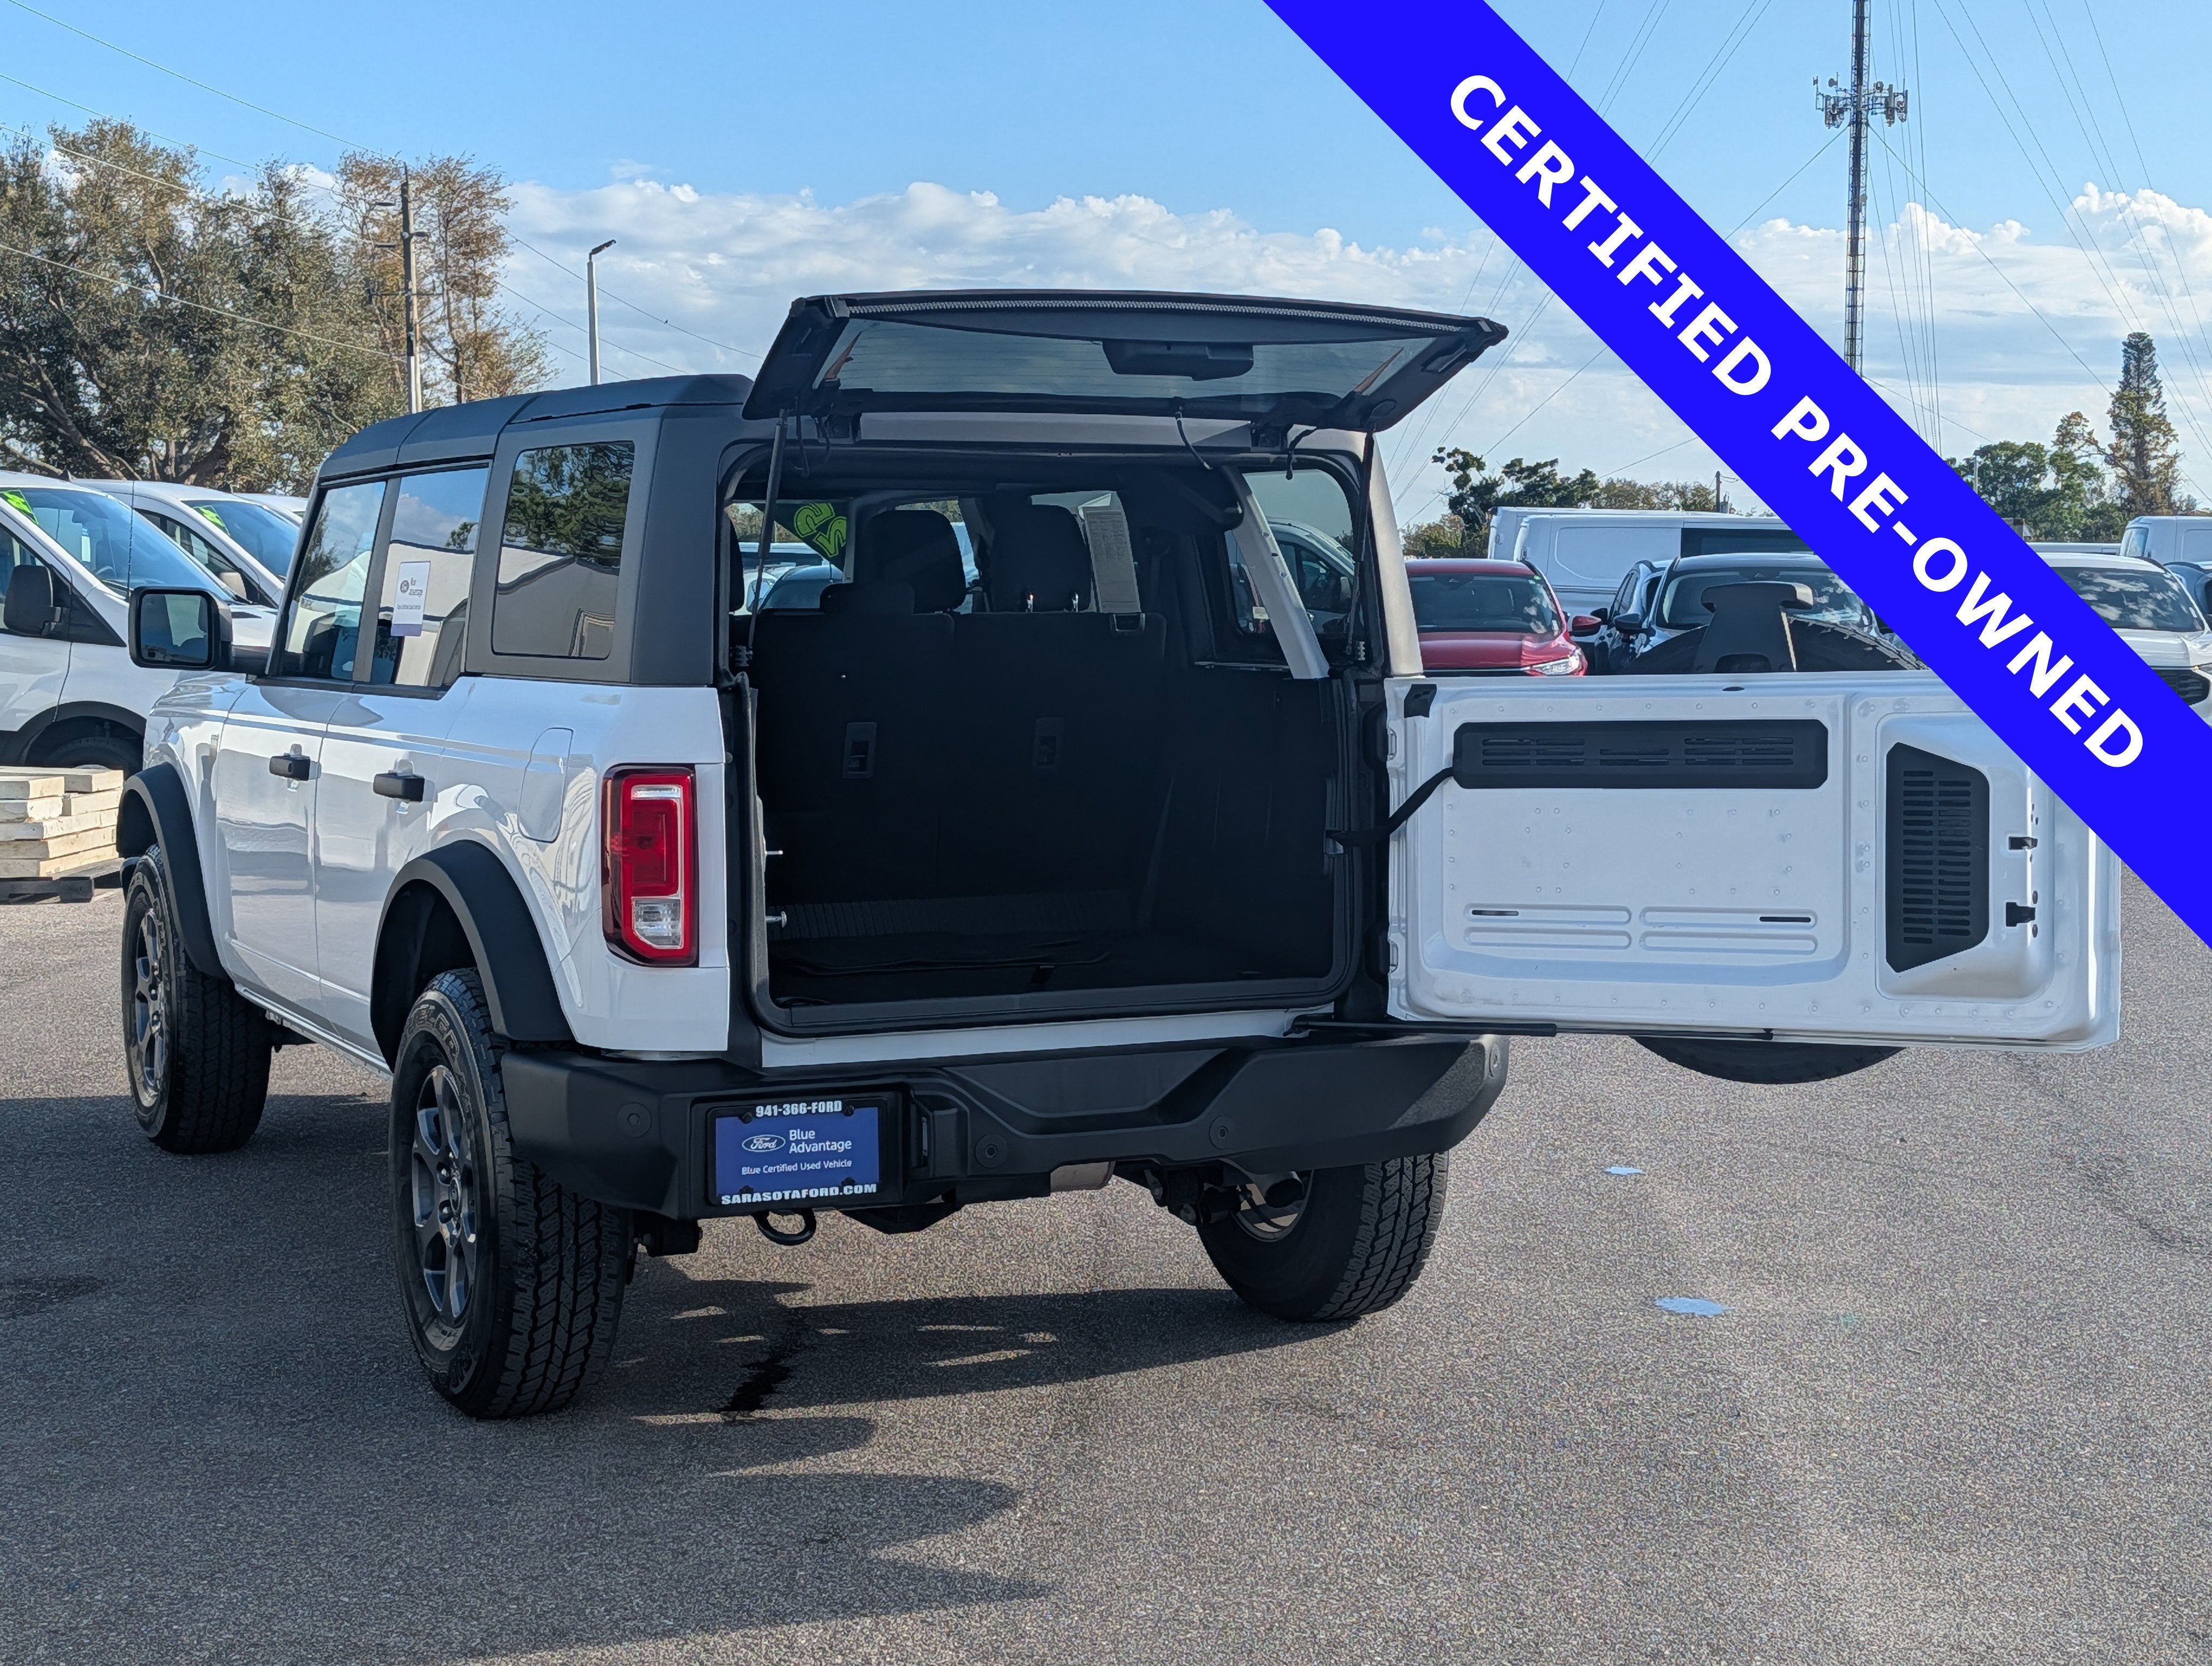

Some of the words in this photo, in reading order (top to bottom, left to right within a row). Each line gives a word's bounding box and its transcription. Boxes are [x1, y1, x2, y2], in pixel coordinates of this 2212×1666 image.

[756, 1100, 843, 1118] 941-366-FORD
[789, 1129, 815, 1140] Blue
[789, 1140, 852, 1154] Advantage
[742, 1167, 760, 1175] Blue
[763, 1163, 798, 1174] Certified
[801, 1161, 821, 1170] Used
[824, 1159, 852, 1168] Vehicle
[722, 1184, 877, 1205] SARASOTAFORD.COM
